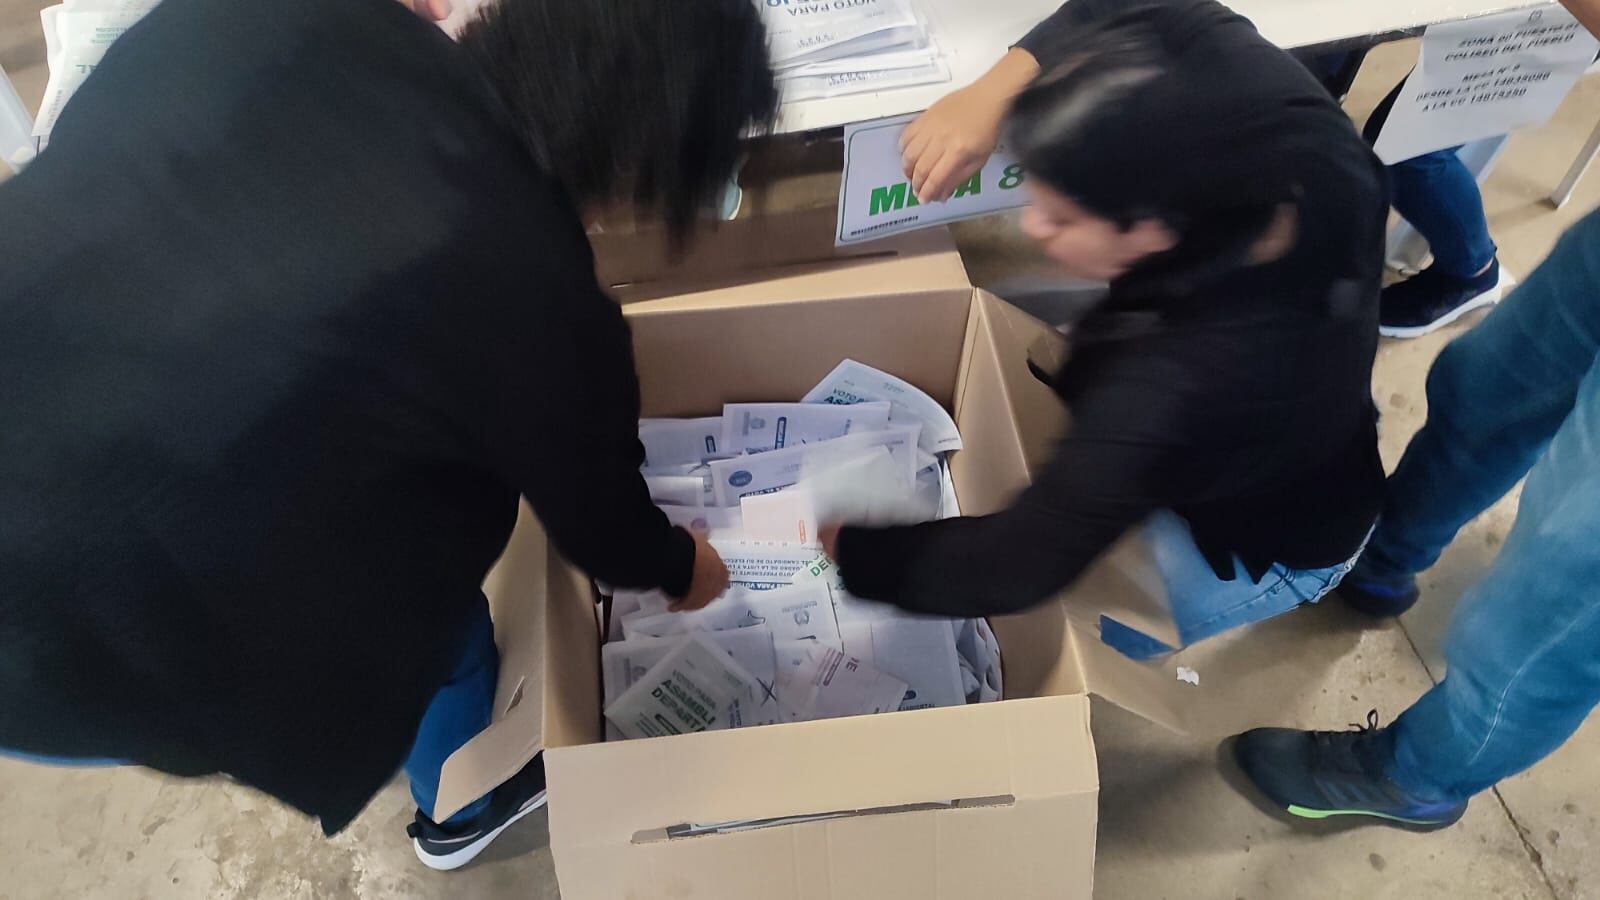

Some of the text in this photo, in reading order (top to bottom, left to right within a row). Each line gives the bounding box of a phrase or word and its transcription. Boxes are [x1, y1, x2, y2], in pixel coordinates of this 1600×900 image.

[787, 3, 829, 16] PARA
[1445, 34, 1575, 62] COLISEO DEL PUEBLO
[998, 164, 1024, 190] 8
